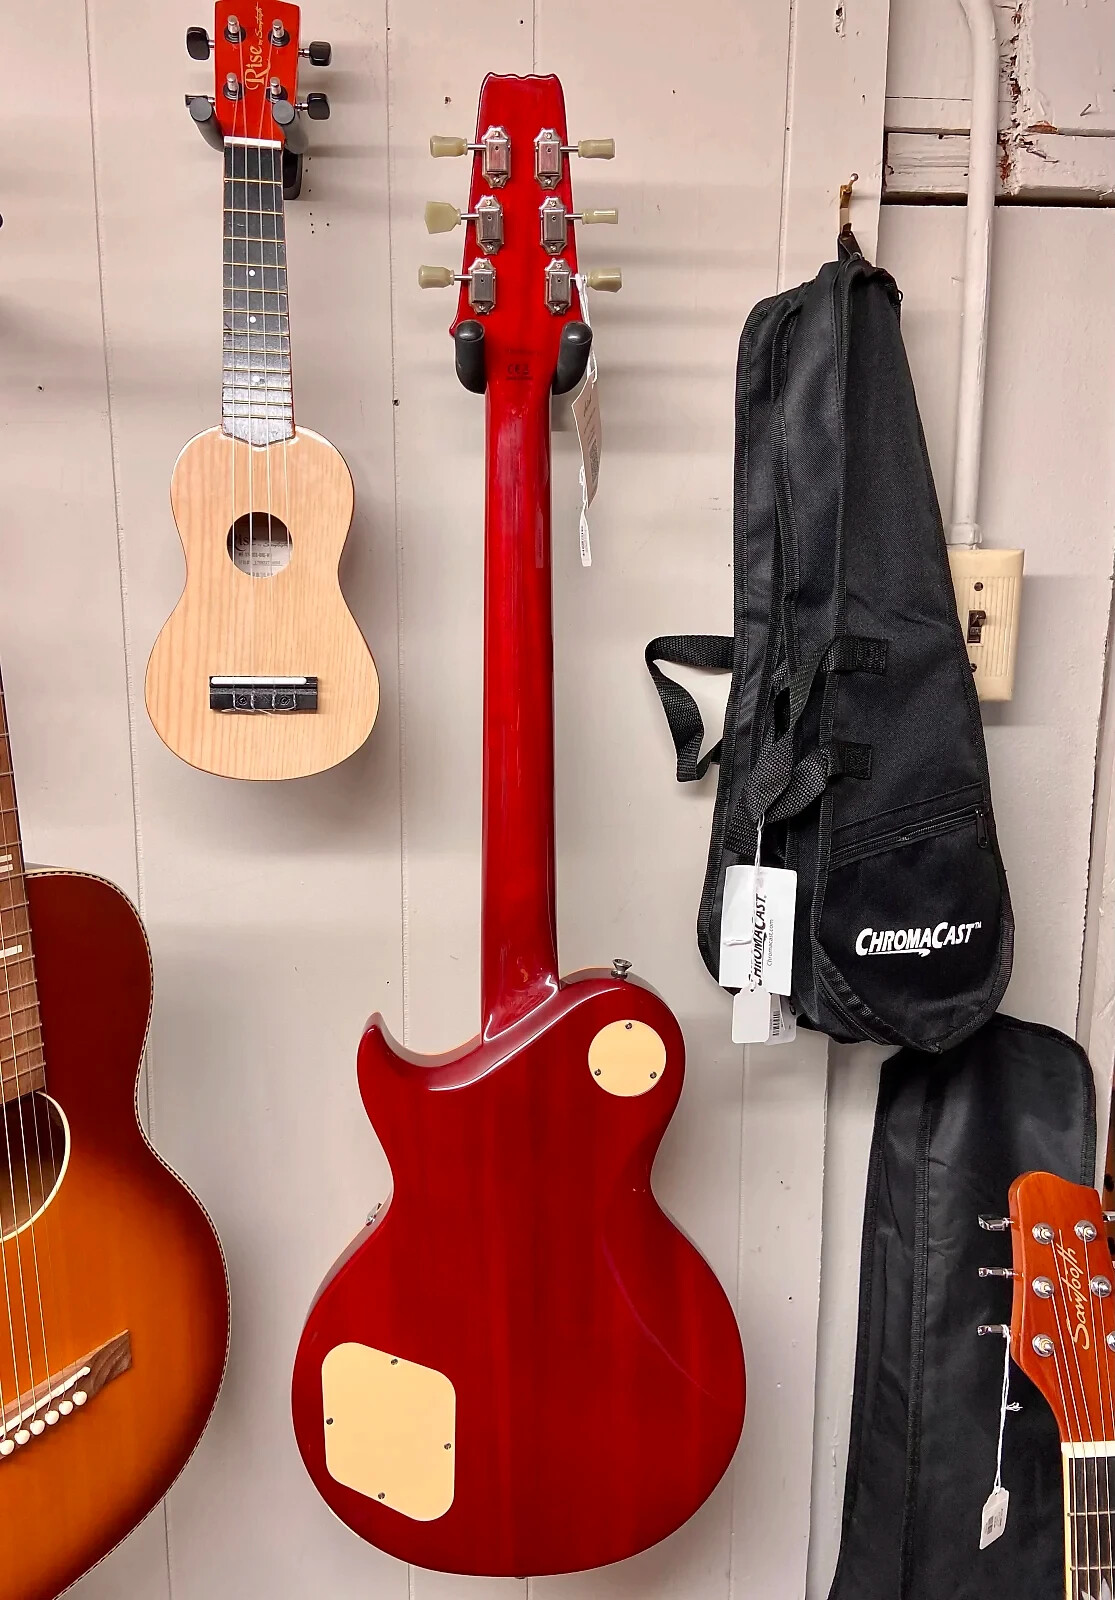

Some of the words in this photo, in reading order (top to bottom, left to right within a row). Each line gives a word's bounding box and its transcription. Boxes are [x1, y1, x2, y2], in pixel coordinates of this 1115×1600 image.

[245, 46, 270, 90] Rise
[767, 919, 775, 967] Chromacast.com
[1056, 1229, 1090, 1350] Sawtooth
